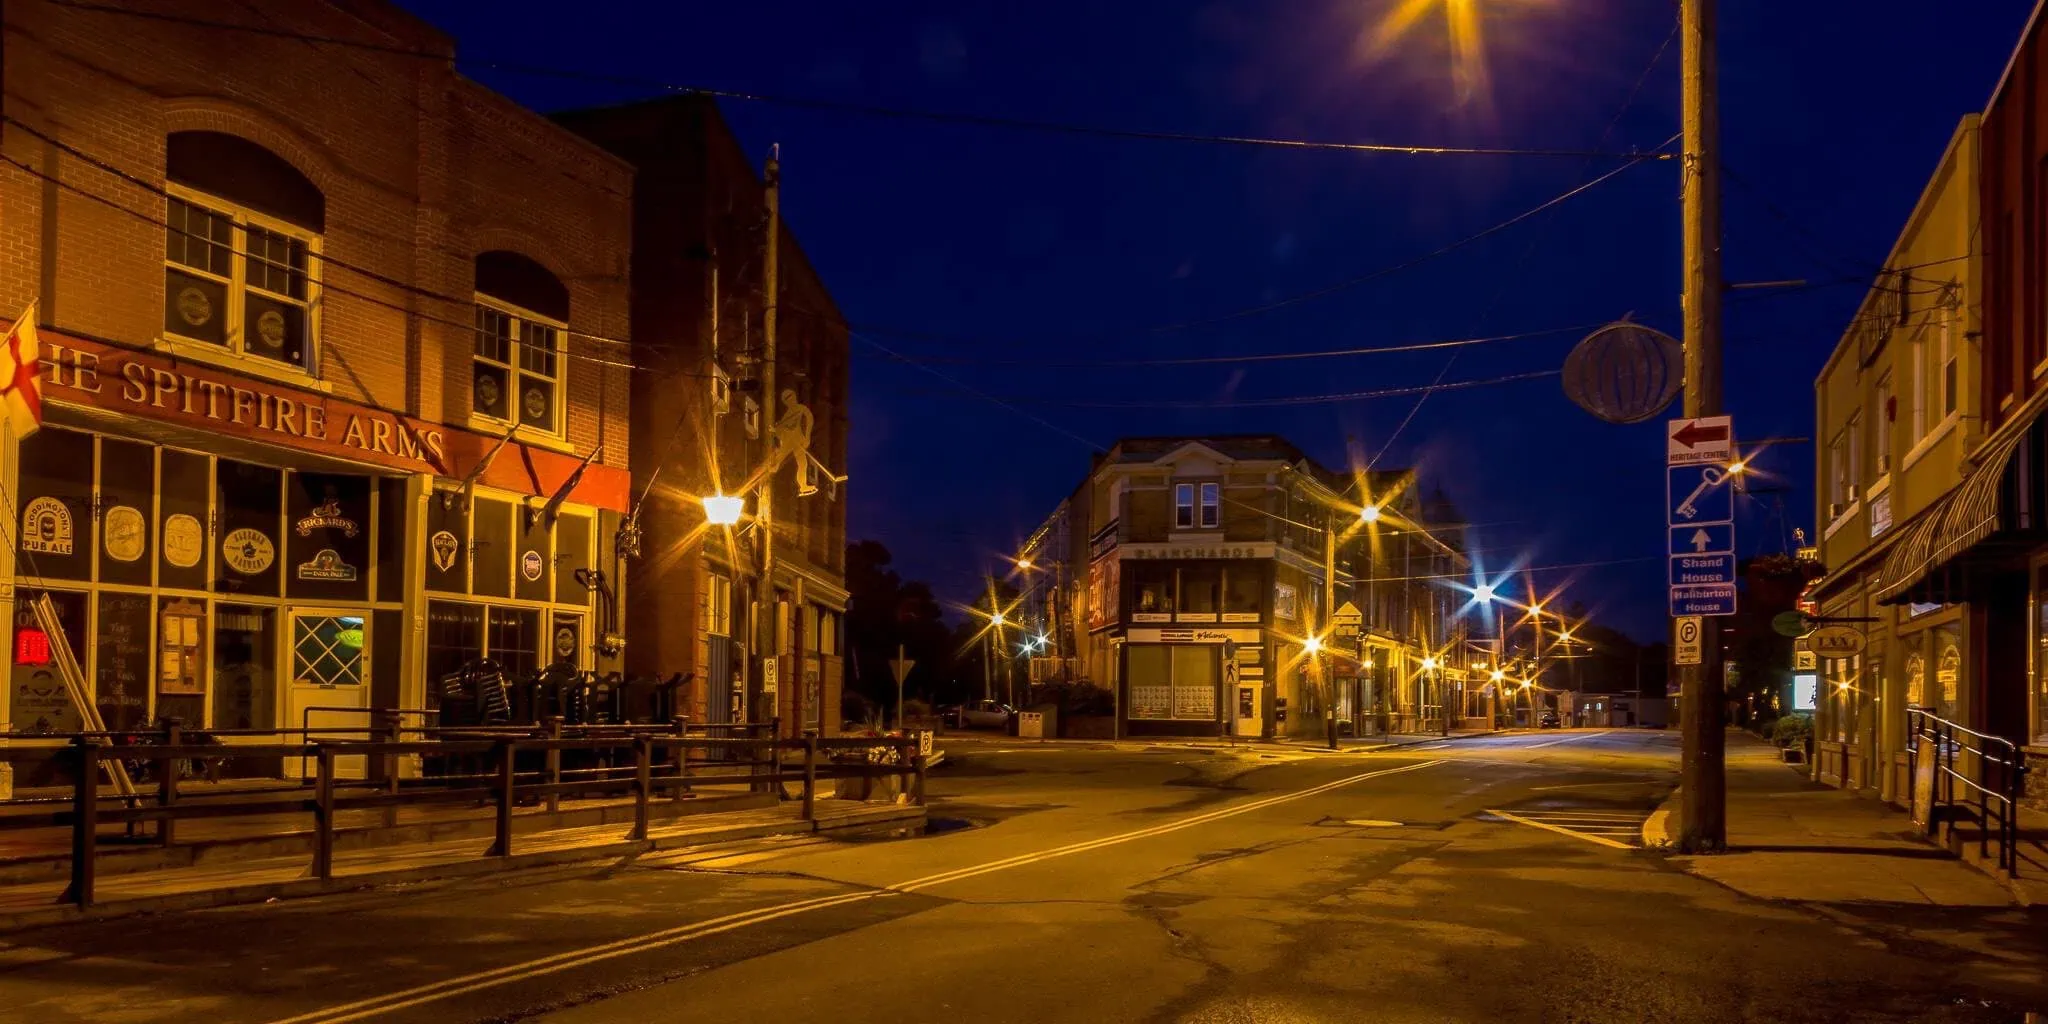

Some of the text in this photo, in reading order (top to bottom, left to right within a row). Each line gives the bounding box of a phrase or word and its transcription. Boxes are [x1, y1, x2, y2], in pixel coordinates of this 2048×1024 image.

[38, 342, 444, 462] HE SPITFIRE ARMS
[1670, 450, 1728, 461] HERITAGE CENTRE
[302, 517, 353, 530] RICKARD'S
[24, 540, 72, 554] PUB ALE
[1135, 547, 1256, 559] BLANCHARDS
[1682, 558, 1724, 568] Shand
[1682, 573, 1724, 583] House
[1674, 590, 1732, 600] Haliburton
[1686, 603, 1721, 612] House
